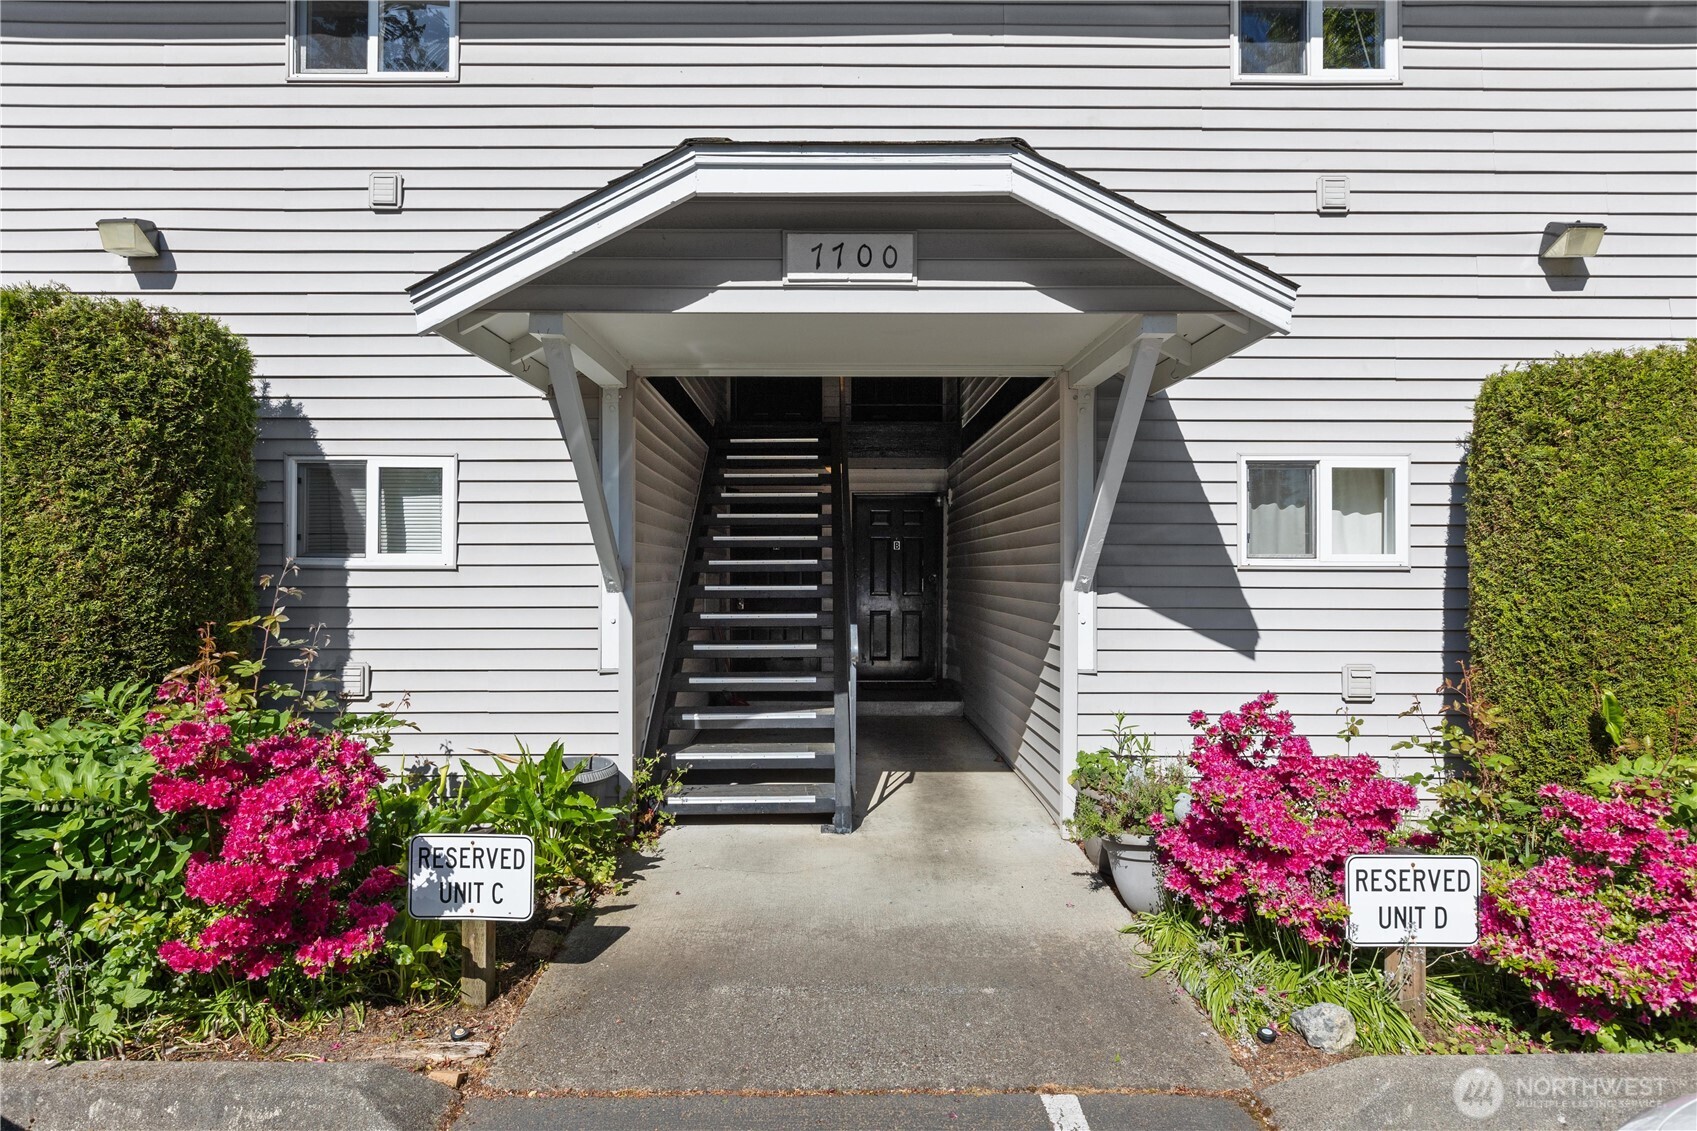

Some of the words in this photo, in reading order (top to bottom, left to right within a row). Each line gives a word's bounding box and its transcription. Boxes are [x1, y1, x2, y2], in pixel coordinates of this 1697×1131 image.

[811, 242, 898, 270] 1100
[894, 541, 900, 550] B
[418, 847, 526, 870] RESERVED
[1356, 869, 1471, 892] RESERVED
[440, 882, 484, 904] UNIT
[492, 882, 504, 904] C
[1379, 906, 1426, 929] UNIT
[1435, 906, 1448, 929] D
